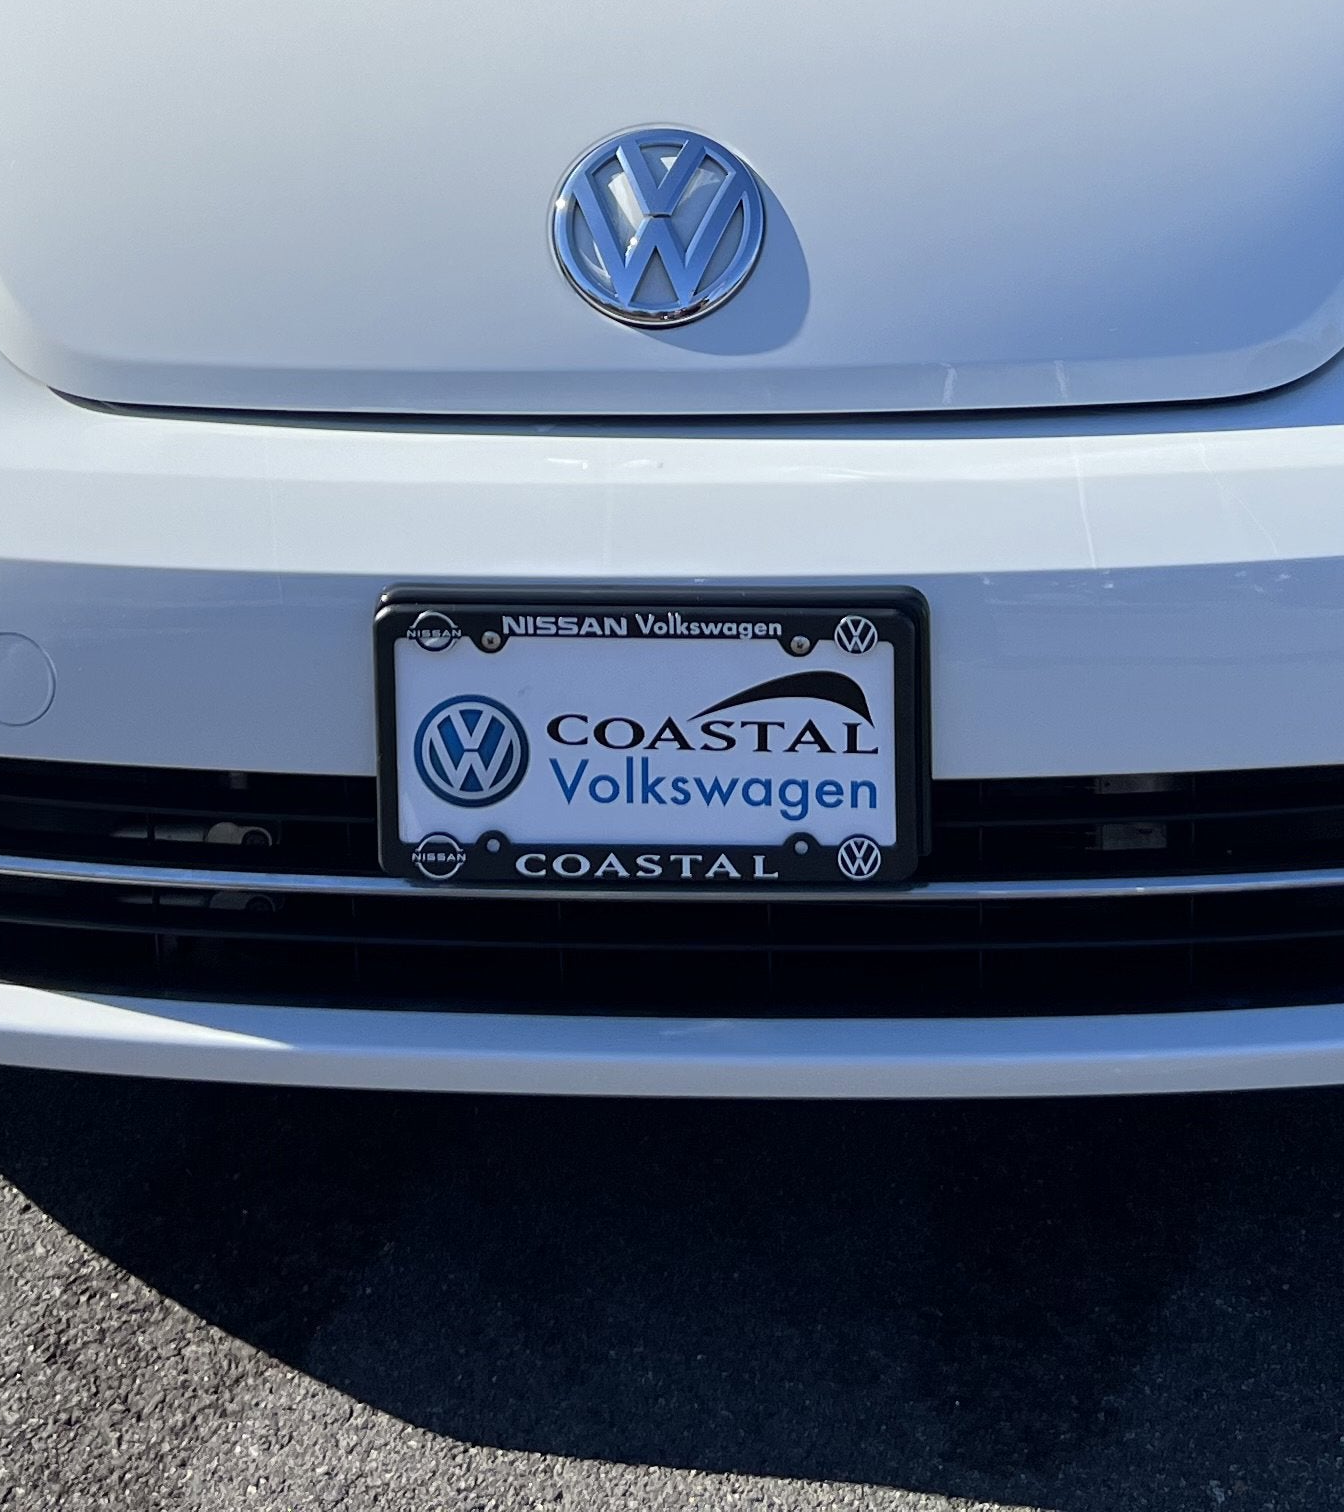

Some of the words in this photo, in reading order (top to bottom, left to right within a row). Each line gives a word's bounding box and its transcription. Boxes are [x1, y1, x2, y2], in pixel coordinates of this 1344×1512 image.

[407, 629, 462, 638] NISSAN
[502, 615, 627, 636] NISSAN
[635, 612, 782, 639] Volkswagen
[546, 714, 879, 754] COASTAL
[549, 756, 877, 821] Volkswagen
[411, 852, 467, 862] NISSAN
[515, 853, 779, 879] COASTAL
